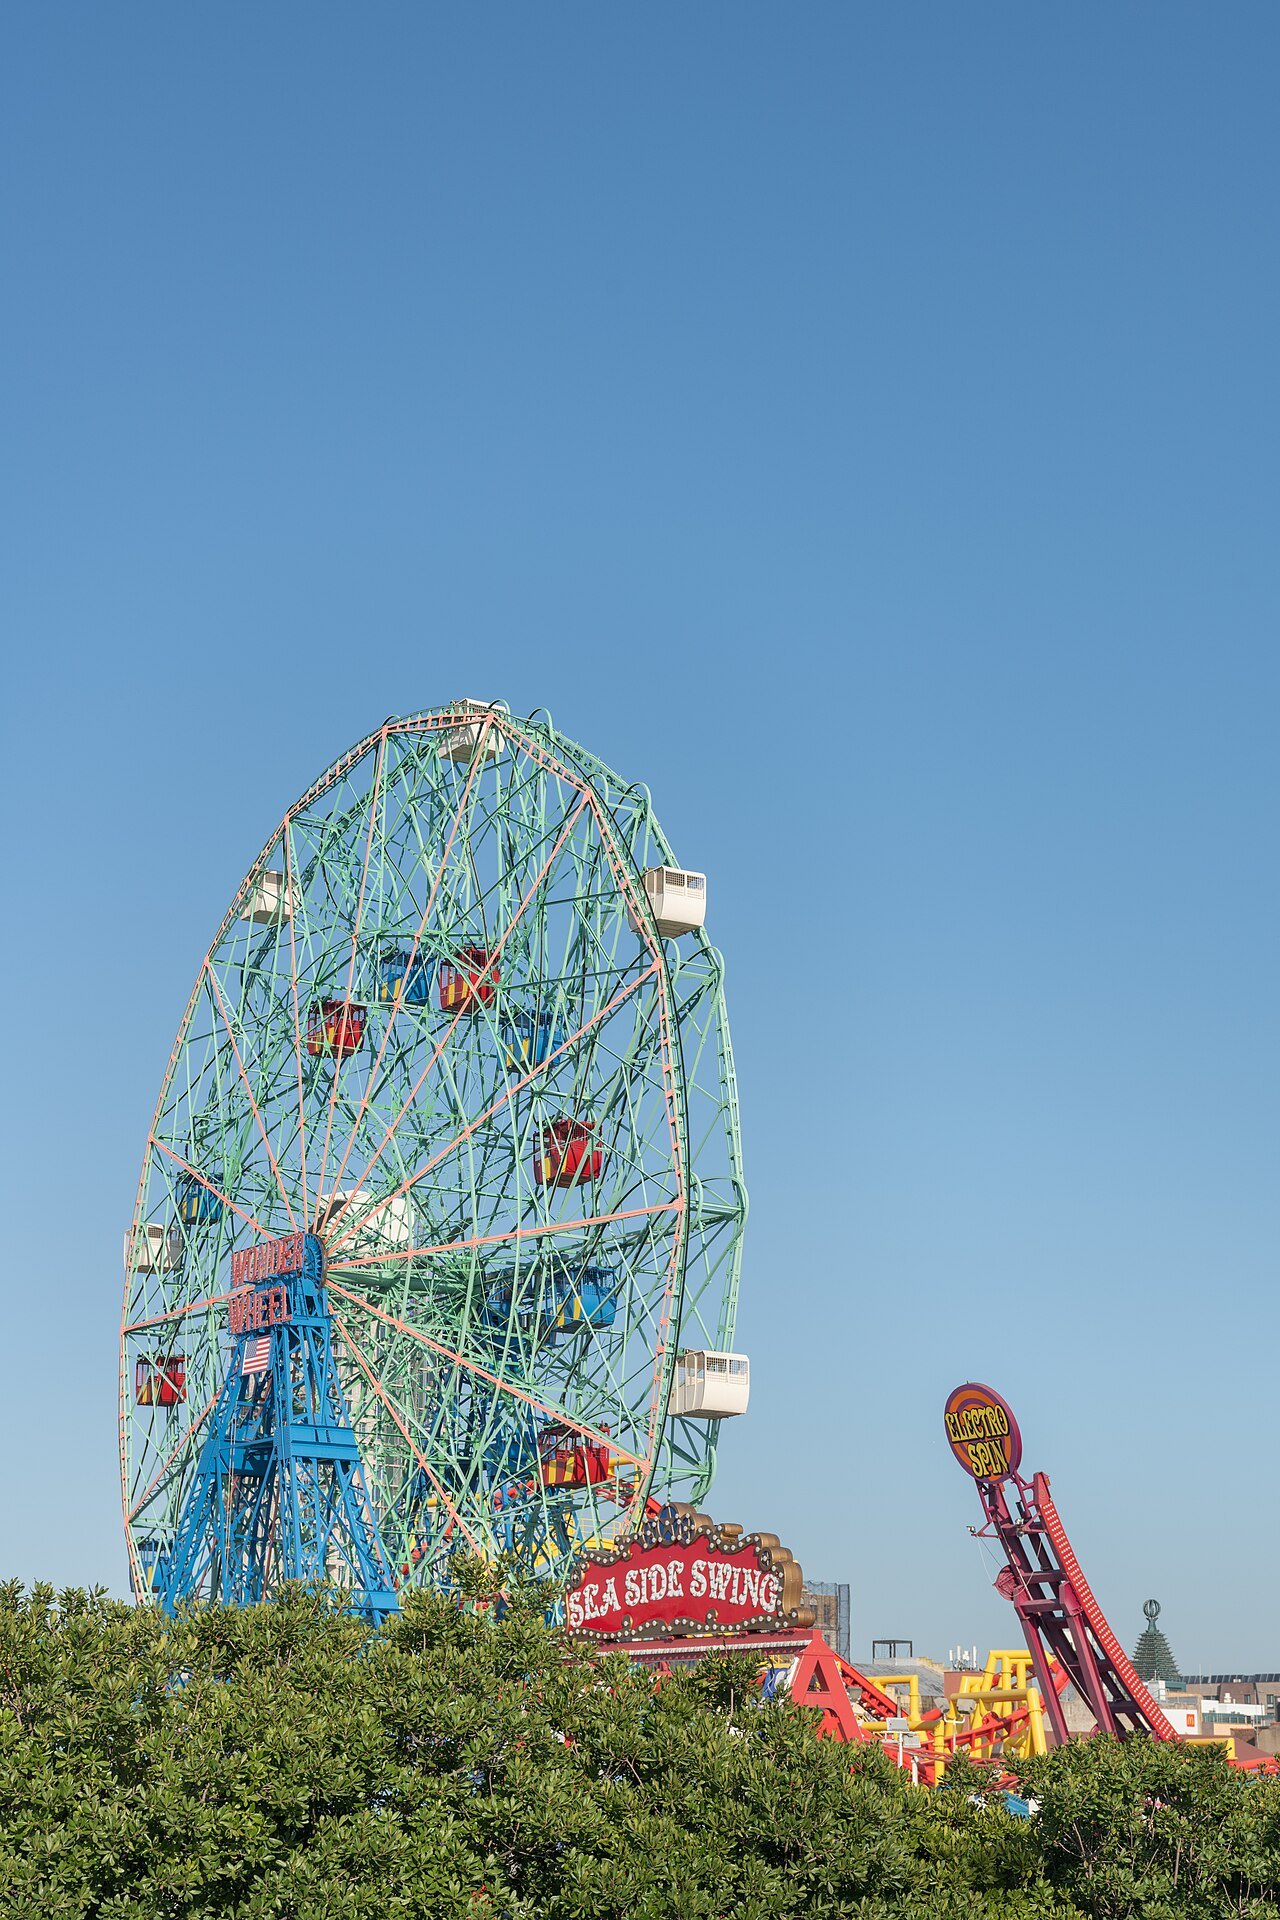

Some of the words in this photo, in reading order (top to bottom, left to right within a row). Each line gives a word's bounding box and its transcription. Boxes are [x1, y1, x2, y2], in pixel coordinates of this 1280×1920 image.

[231, 1232, 303, 1288] WONDER
[229, 1286, 292, 1335] WHEEL
[945, 1404, 1009, 1442] ELECTRO
[968, 1439, 1009, 1477] SPIN
[569, 1577, 622, 1628] SEA
[625, 1559, 684, 1607] SIDE
[689, 1560, 779, 1613] SWING
